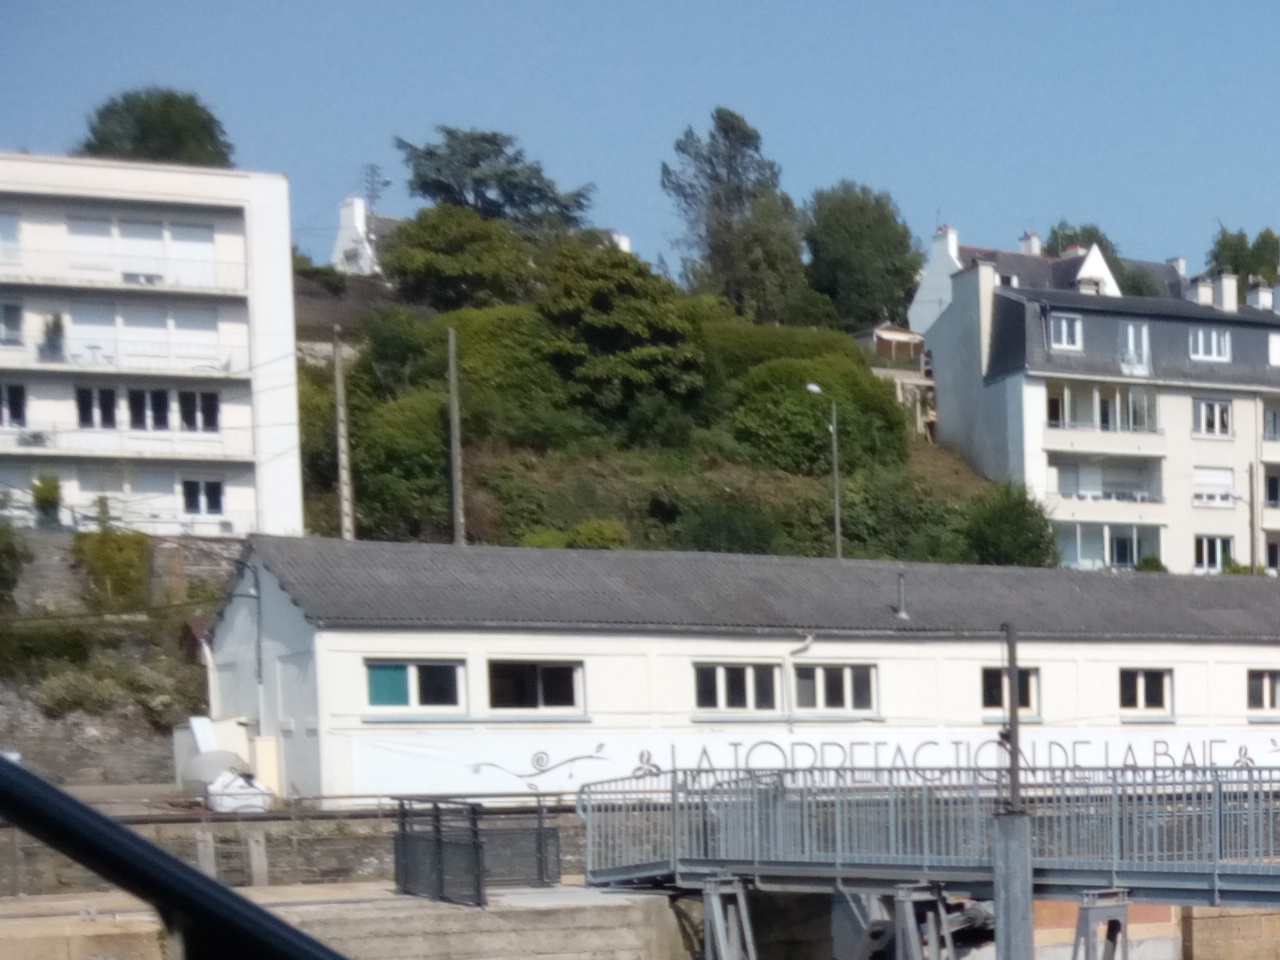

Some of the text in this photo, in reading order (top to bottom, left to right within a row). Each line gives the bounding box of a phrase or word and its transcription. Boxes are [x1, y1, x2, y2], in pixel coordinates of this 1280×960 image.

[1048, 741, 1093, 780] DE
[1104, 740, 1143, 780] LA
[1153, 740, 1227, 780] BAIE
